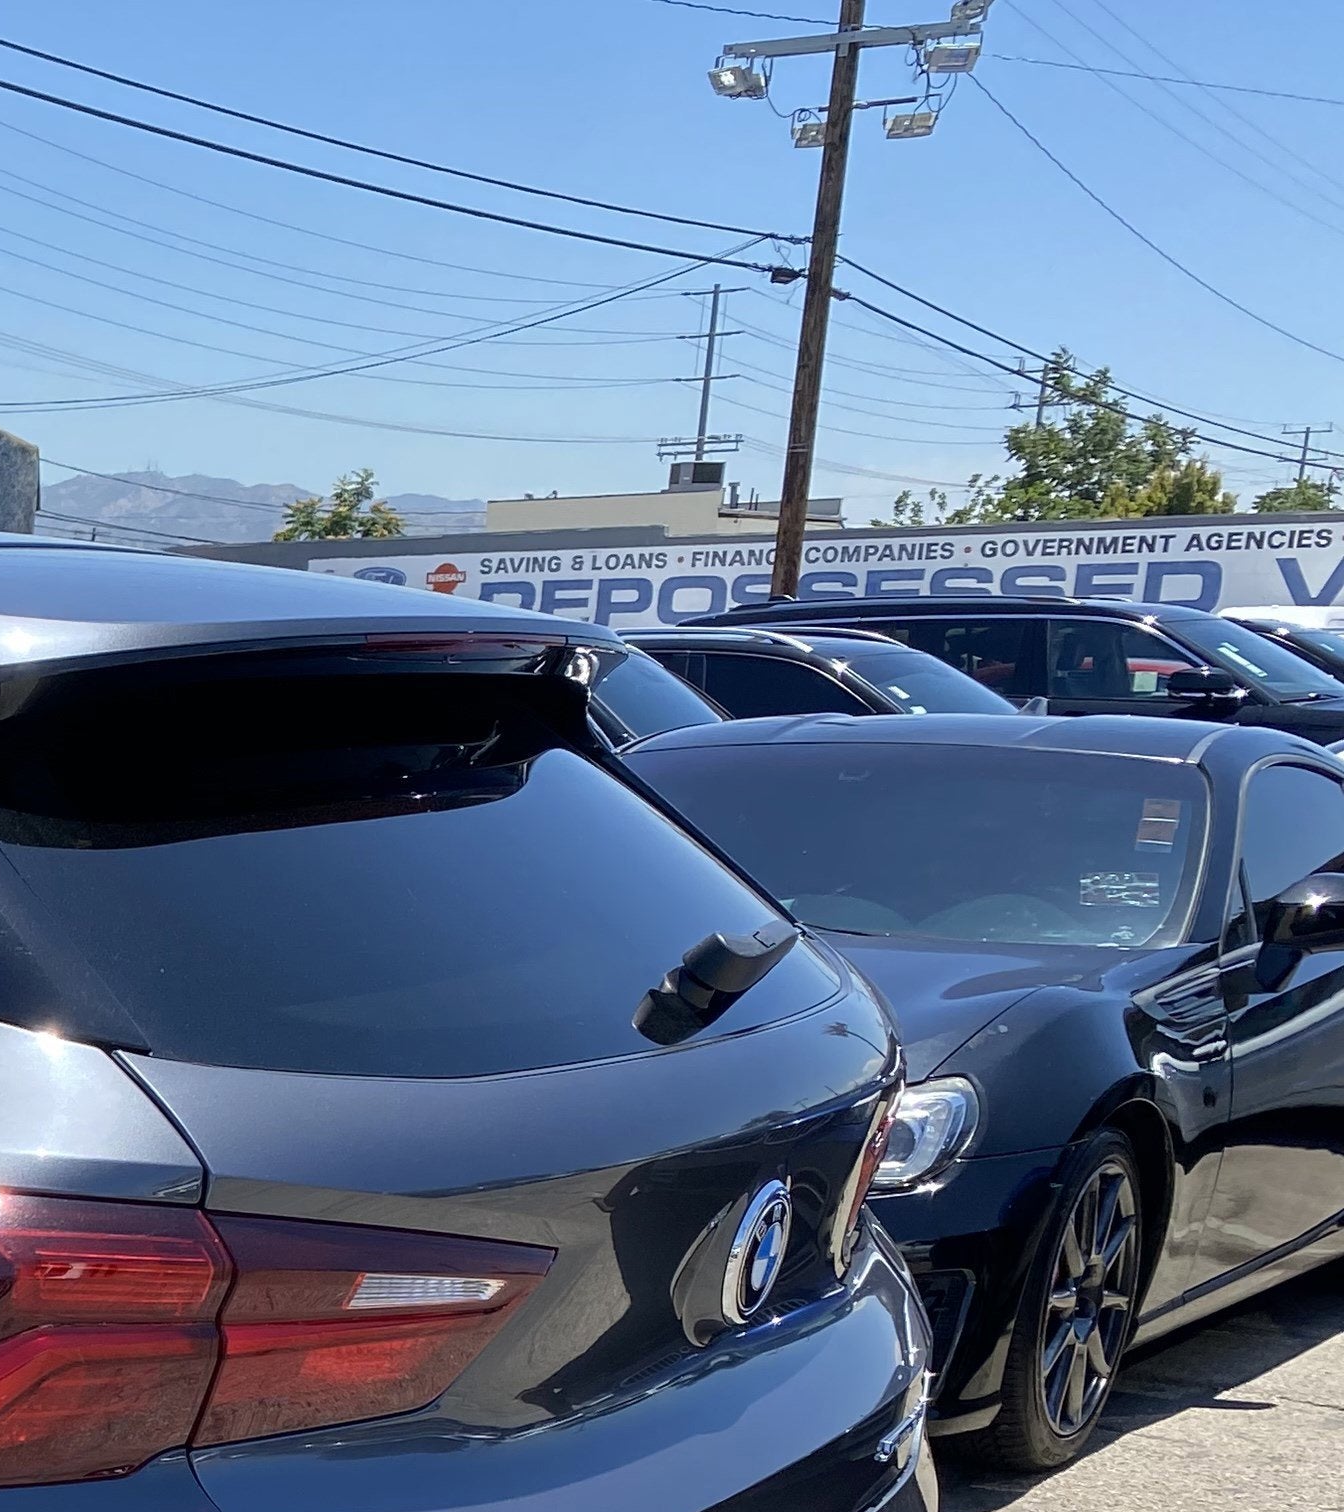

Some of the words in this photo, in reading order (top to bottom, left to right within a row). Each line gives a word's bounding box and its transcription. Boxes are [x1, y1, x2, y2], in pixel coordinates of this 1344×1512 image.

[479, 555, 562, 574] SAVING
[571, 555, 585, 571] &
[592, 552, 668, 571] LOANS
[691, 548, 776, 568] FINANC
[804, 542, 955, 564] COMPANIES
[980, 534, 1176, 558] GOVERNMENT
[1184, 528, 1333, 552] AGENCIES
[427, 572, 466, 583] NISSAN
